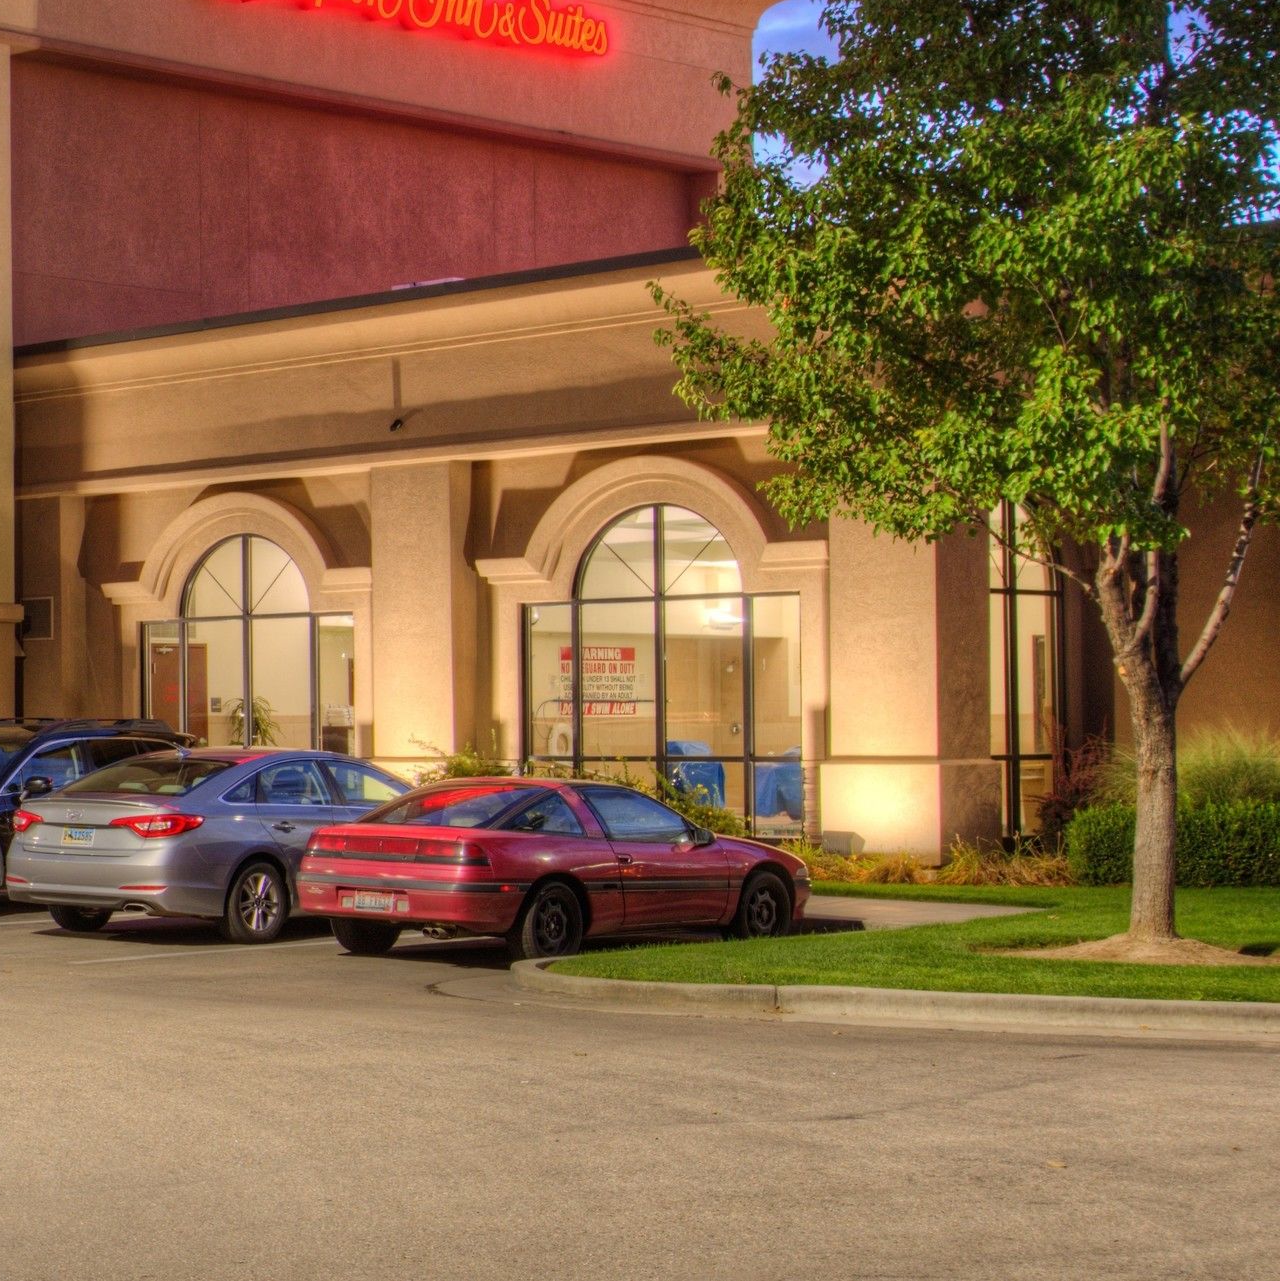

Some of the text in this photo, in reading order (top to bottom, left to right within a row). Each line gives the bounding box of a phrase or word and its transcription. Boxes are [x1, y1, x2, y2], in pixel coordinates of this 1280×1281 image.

[582, 648, 621, 660] ARNING
[560, 662, 570, 674] NO
[608, 662, 618, 674] ON
[620, 662, 635, 674] DUTY
